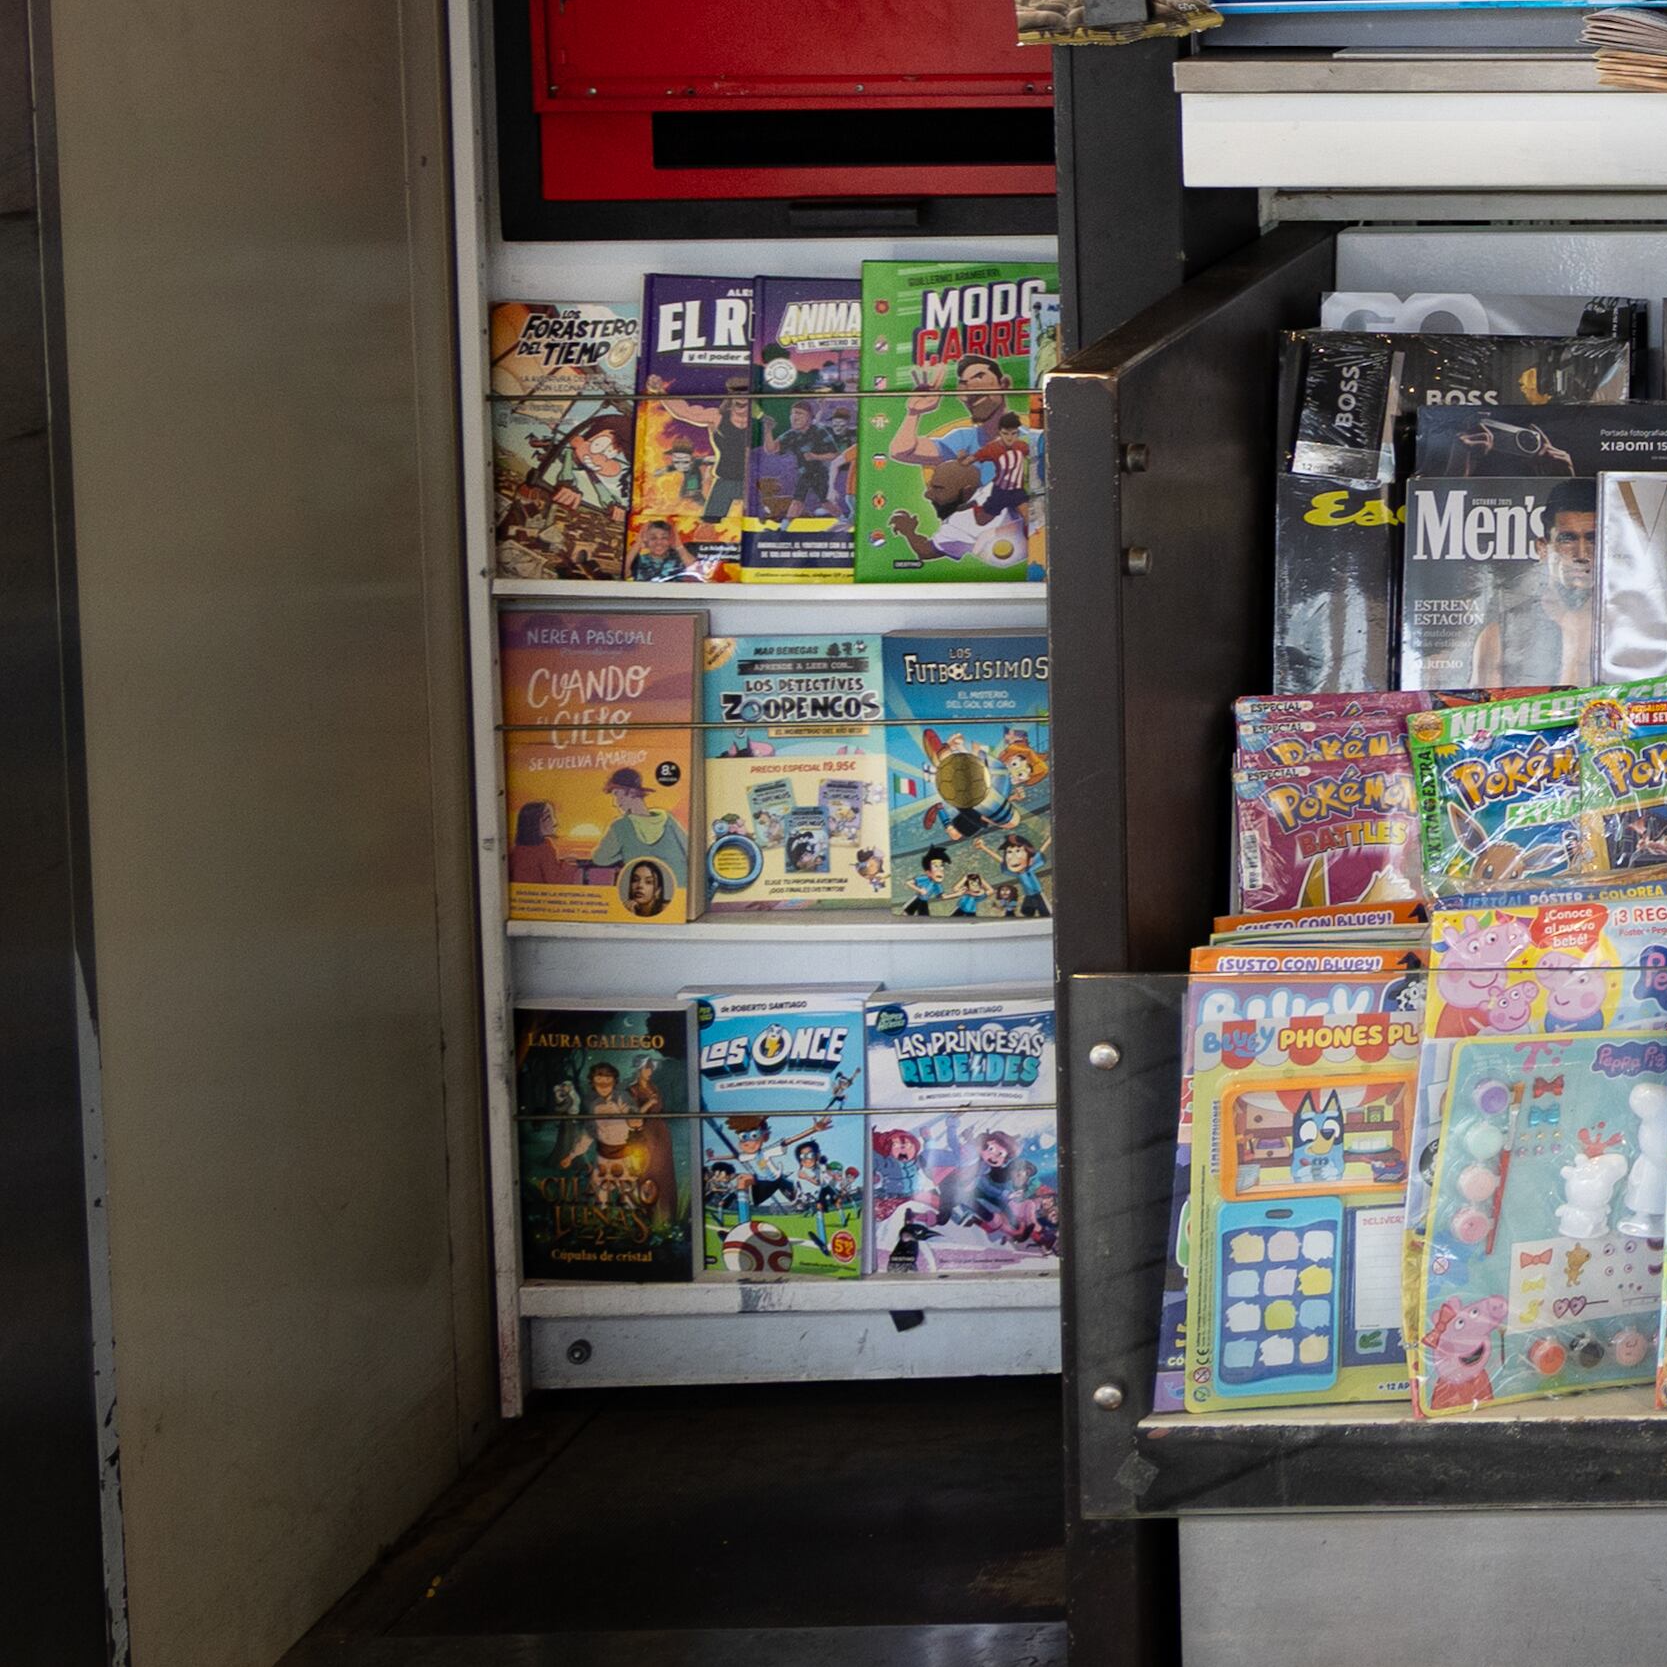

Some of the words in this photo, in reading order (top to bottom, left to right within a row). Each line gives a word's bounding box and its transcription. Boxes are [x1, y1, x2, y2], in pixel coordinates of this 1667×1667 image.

[1426, 389, 1497, 406] BOSS
[529, 1035, 583, 1050] LAURA
[587, 1035, 664, 1049] GALLEGO
